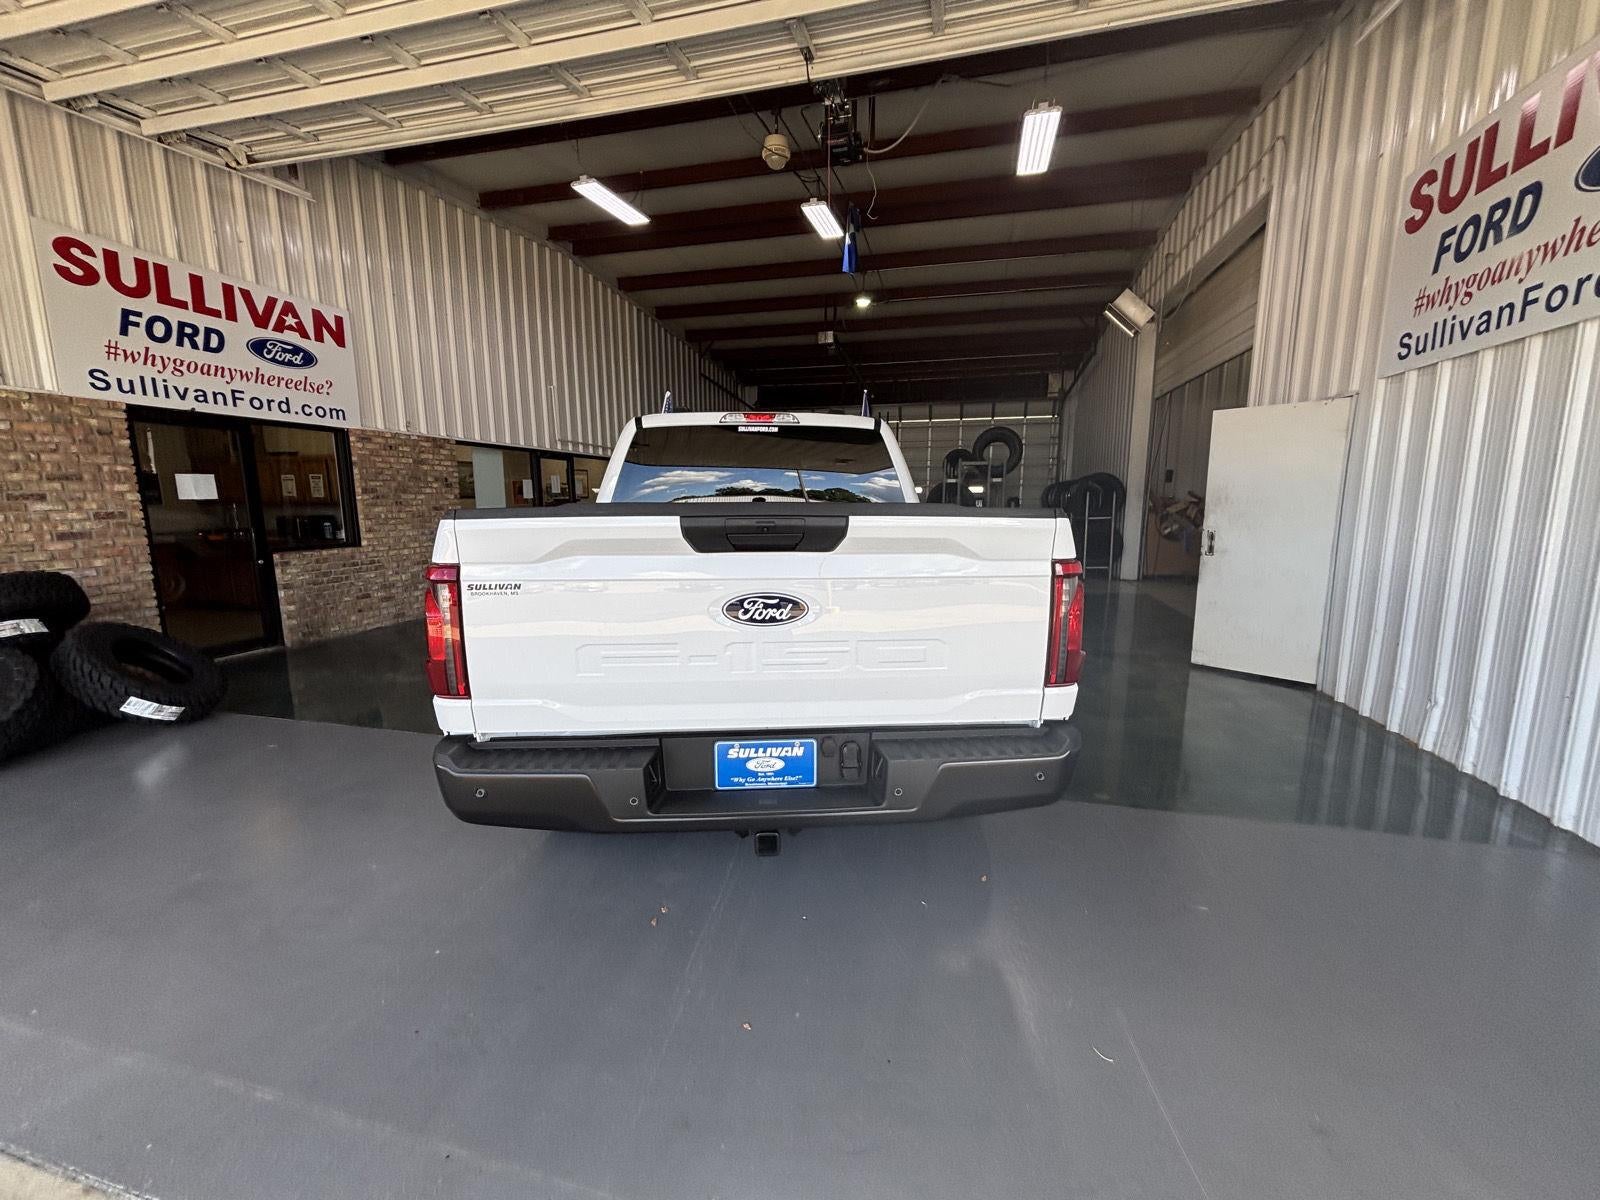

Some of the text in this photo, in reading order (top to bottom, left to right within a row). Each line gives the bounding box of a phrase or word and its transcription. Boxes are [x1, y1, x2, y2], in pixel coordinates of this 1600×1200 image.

[1404, 50, 1600, 235] SULLI
[1431, 180, 1543, 276] FORD
[51, 235, 346, 349] SULLIVAN
[119, 308, 226, 354] FORD
[263, 340, 304, 365] Ford
[104, 339, 333, 396] #whygoanywhereelse?
[88, 368, 347, 421] SullivanFord.com
[466, 583, 522, 591] SULLIVAN
[738, 598, 792, 620] Ford
[727, 746, 805, 759] SULLIVAN
[754, 759, 777, 769] Ford
